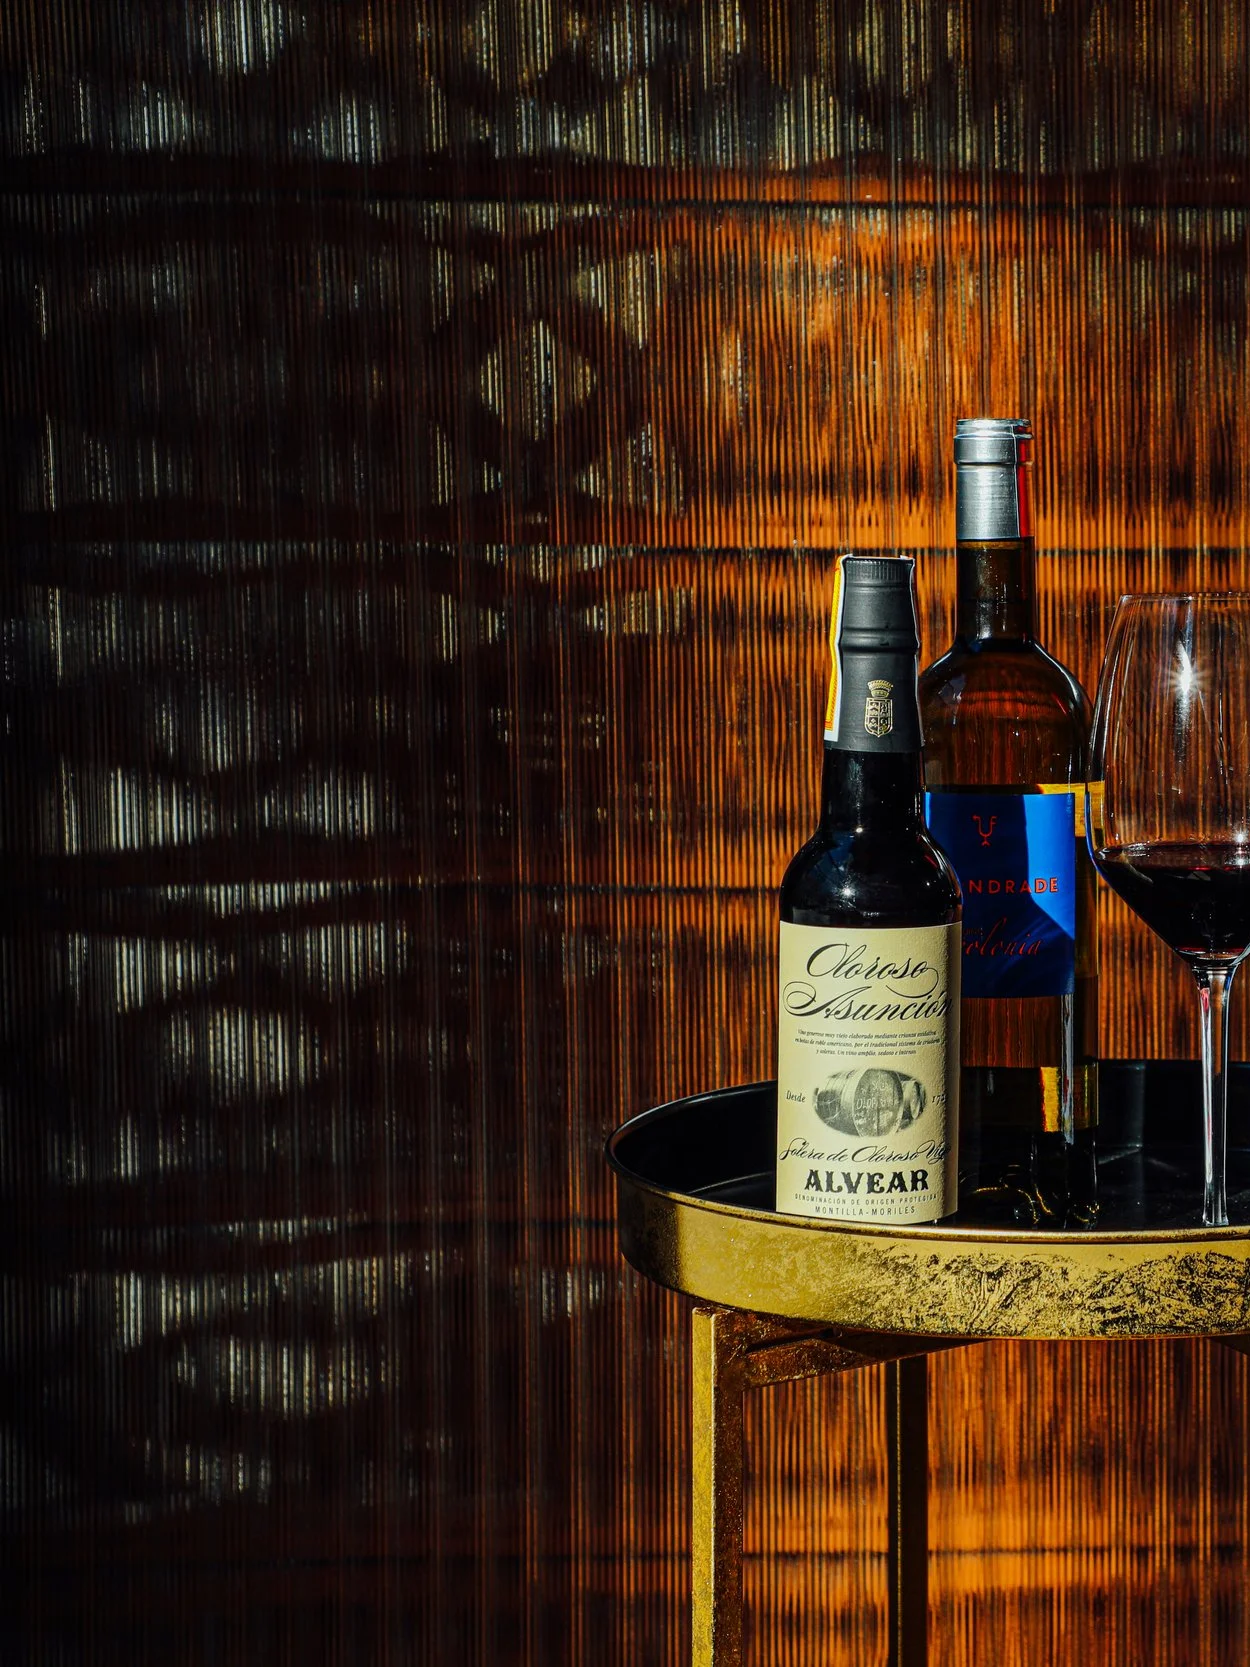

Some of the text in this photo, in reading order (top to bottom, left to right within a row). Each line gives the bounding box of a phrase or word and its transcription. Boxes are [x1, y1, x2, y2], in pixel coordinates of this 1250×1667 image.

[962, 877, 1058, 894] NDRADE
[806, 943, 939, 999] Oloroso
[783, 980, 952, 1021] Asunción
[786, 1090, 806, 1103] Desde
[779, 1137, 825, 1161] Solera
[827, 1148, 849, 1162] de
[852, 1145, 919, 1163] Oloroso
[804, 1169, 929, 1194] ALVEAR
[851, 1198, 860, 1206] DE
[866, 1198, 895, 1206] ORIGEN
[899, 1194, 937, 1204] PROTEGIDA
[815, 1206, 916, 1217] MONTILLA-MORILES
